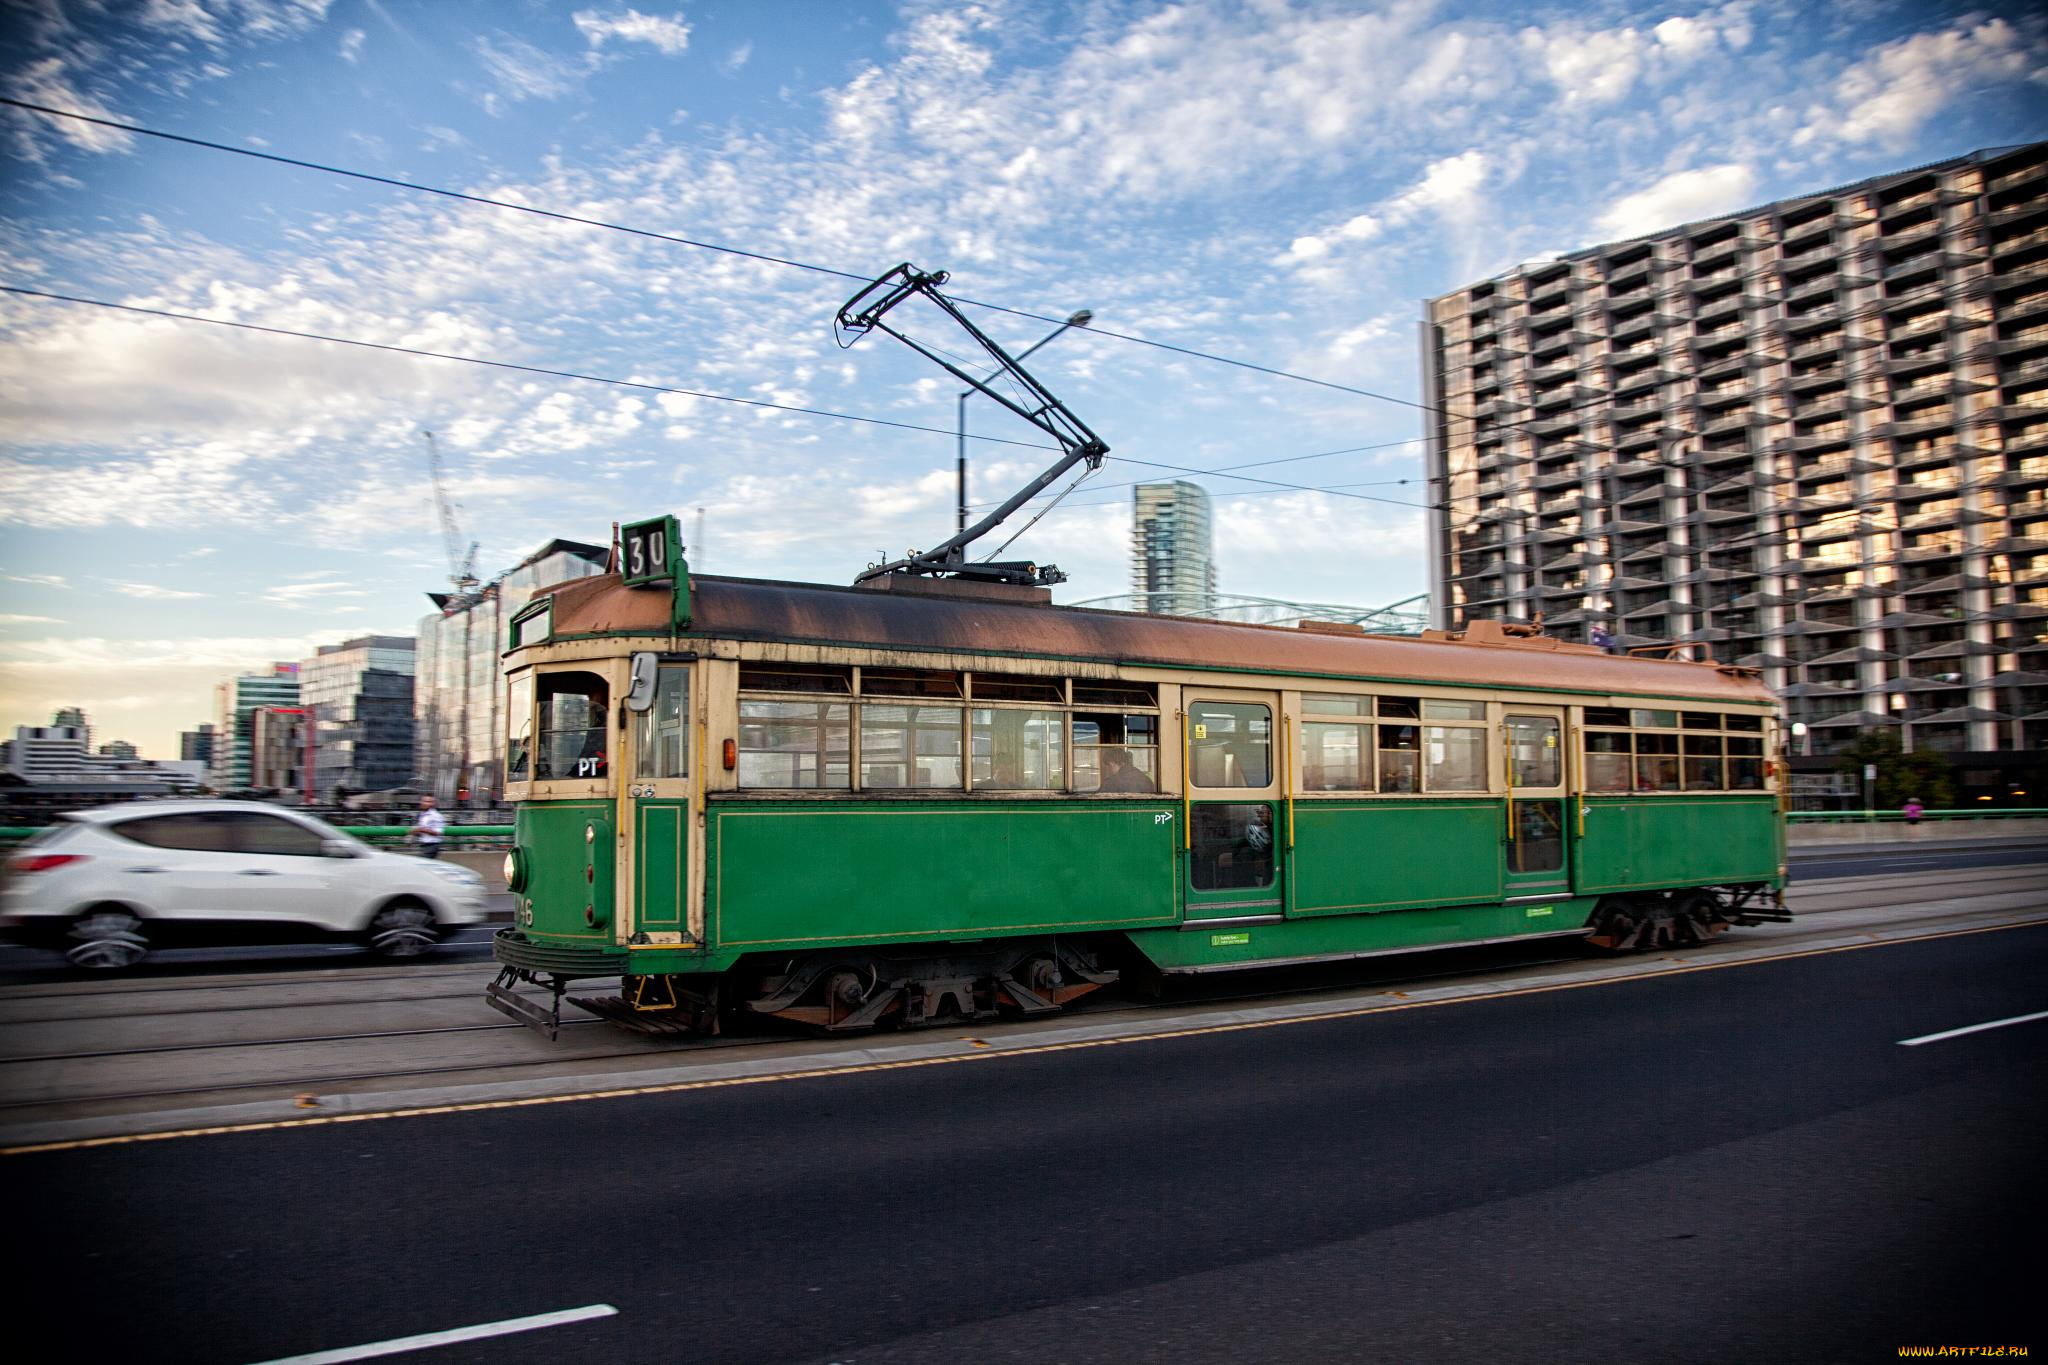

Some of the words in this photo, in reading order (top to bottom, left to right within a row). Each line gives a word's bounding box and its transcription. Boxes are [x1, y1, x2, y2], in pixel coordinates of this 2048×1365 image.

[630, 531, 664, 574] 30
[578, 757, 599, 777] PT
[1154, 814, 1166, 825] PT
